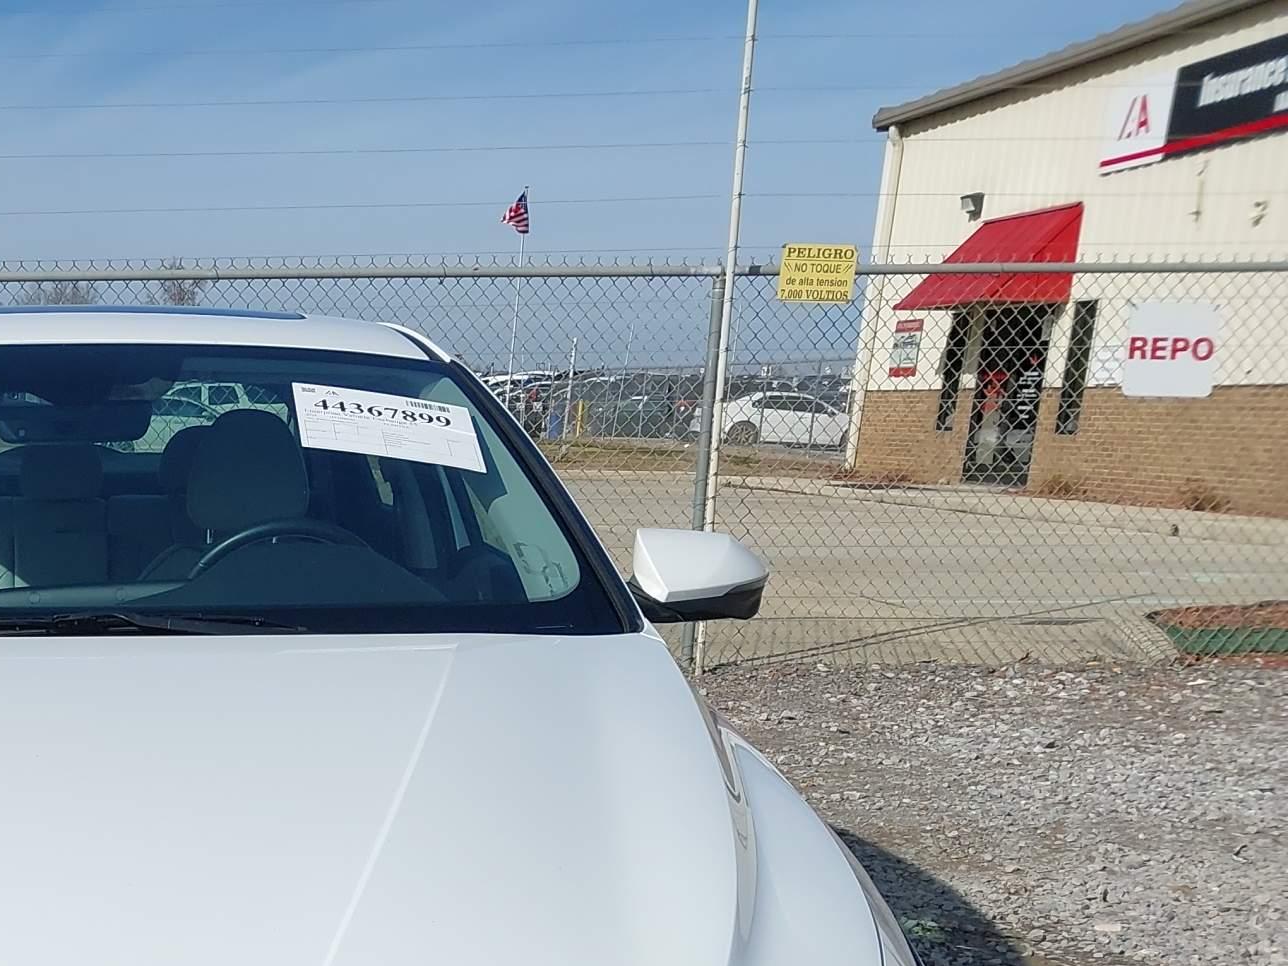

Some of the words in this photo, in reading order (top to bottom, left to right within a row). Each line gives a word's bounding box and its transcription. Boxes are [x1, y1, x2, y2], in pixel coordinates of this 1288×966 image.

[786, 247, 854, 259] PELIGRO
[794, 263, 808, 273] NO
[811, 264, 842, 273] TOQUE
[785, 277, 796, 286] de
[798, 277, 814, 286] alta
[816, 278, 848, 287] tension
[780, 289, 803, 299] 7.000
[806, 289, 848, 300] VOLTIOS
[1128, 336, 1214, 361] REPO
[314, 399, 451, 427] 44367899
